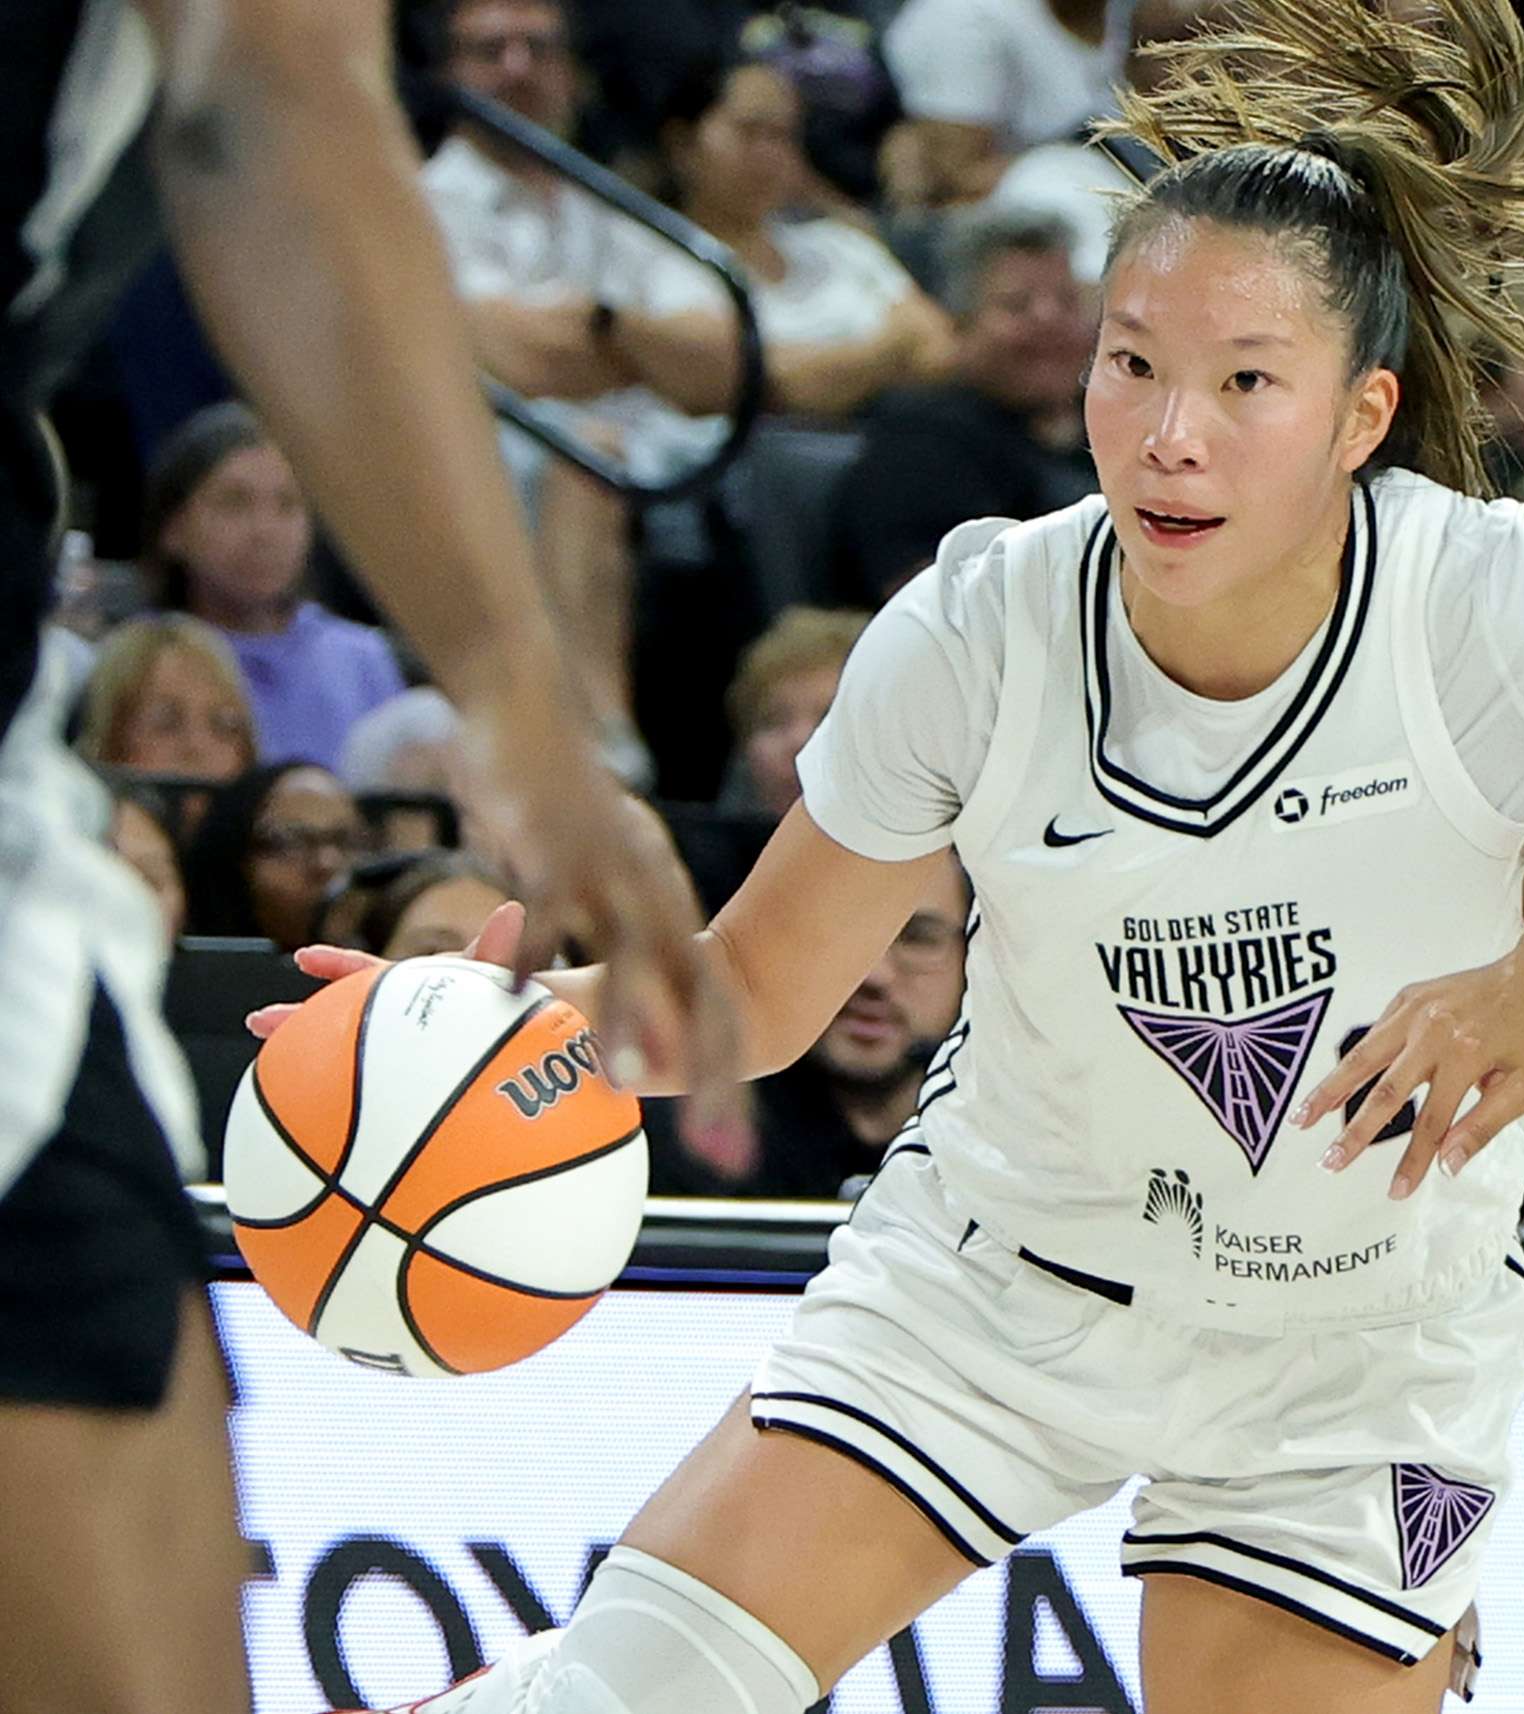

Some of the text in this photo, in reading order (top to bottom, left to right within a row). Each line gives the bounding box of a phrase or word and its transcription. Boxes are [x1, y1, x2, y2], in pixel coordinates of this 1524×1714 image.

[1320, 777, 1408, 816] freedom
[1123, 901, 1299, 942] GOLDEN STATE
[1094, 927, 1337, 1015] VALKYRIES
[1215, 1224, 1303, 1254] KAISER
[1215, 1233, 1398, 1282] PERMANENTE
